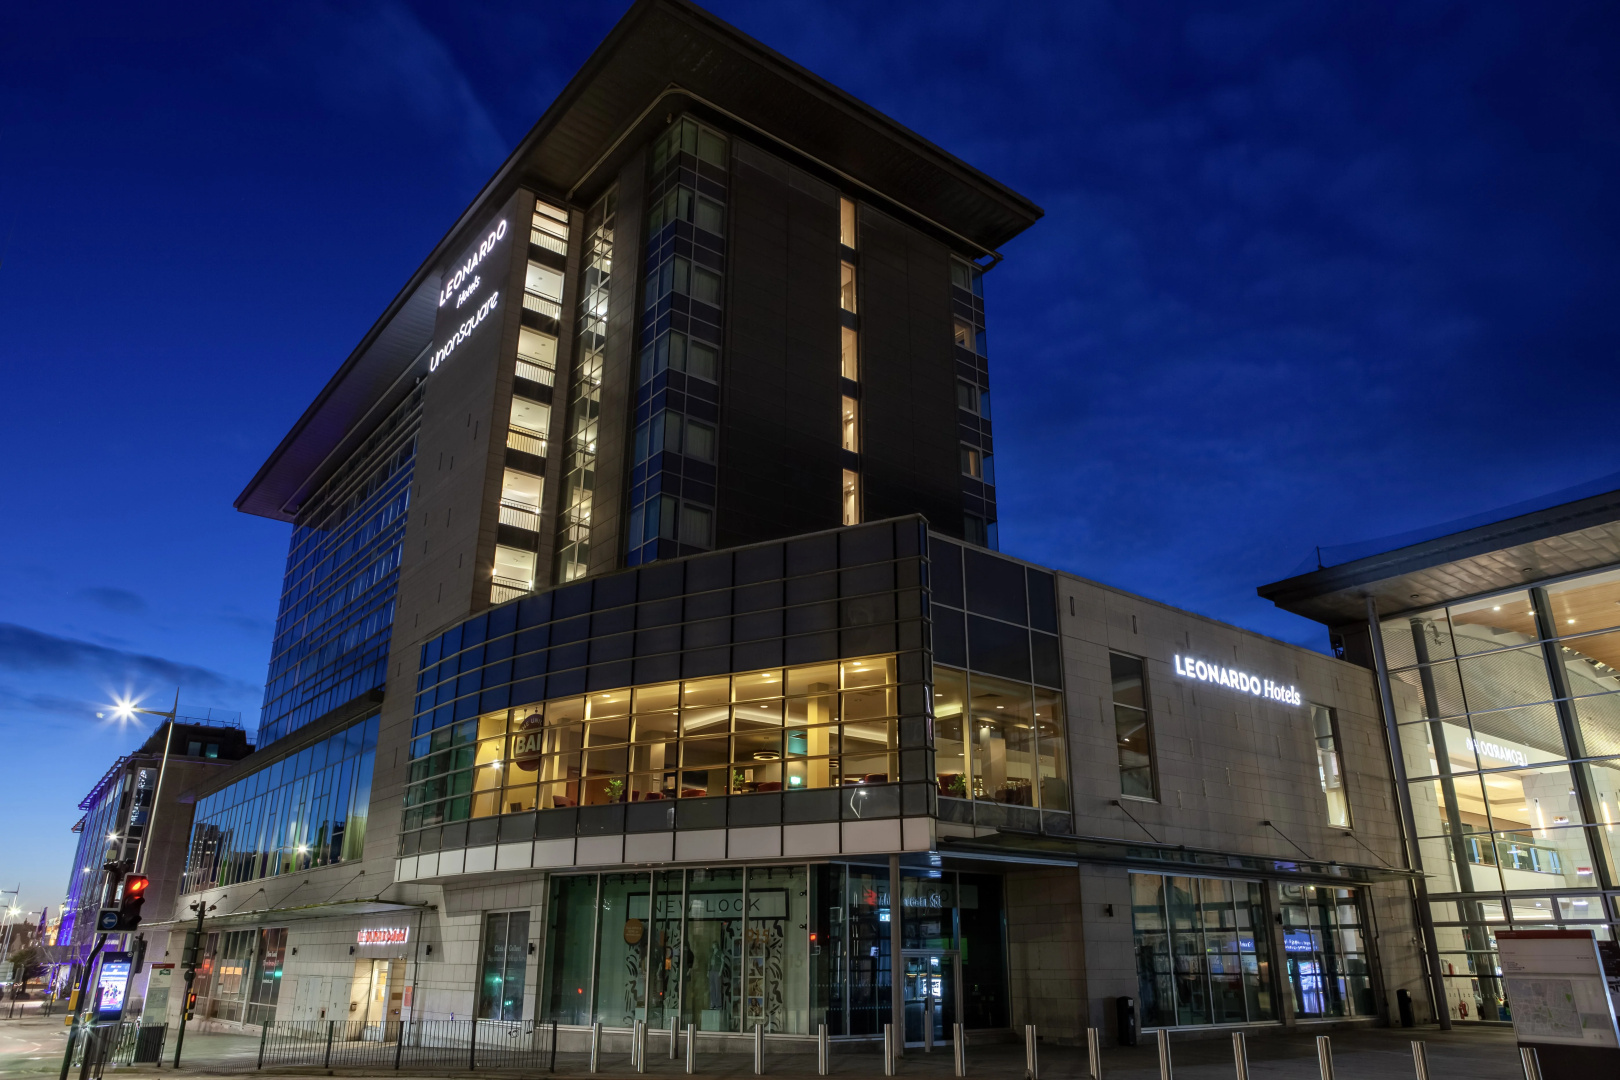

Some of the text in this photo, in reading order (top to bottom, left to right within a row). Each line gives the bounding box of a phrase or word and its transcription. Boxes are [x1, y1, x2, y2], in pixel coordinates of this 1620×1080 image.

[440, 220, 507, 307] LEONARDO
[456, 275, 481, 309] Hotels
[1174, 653, 1301, 706] LEONARDO Hotels
[656, 897, 761, 914] NEW LOOK
